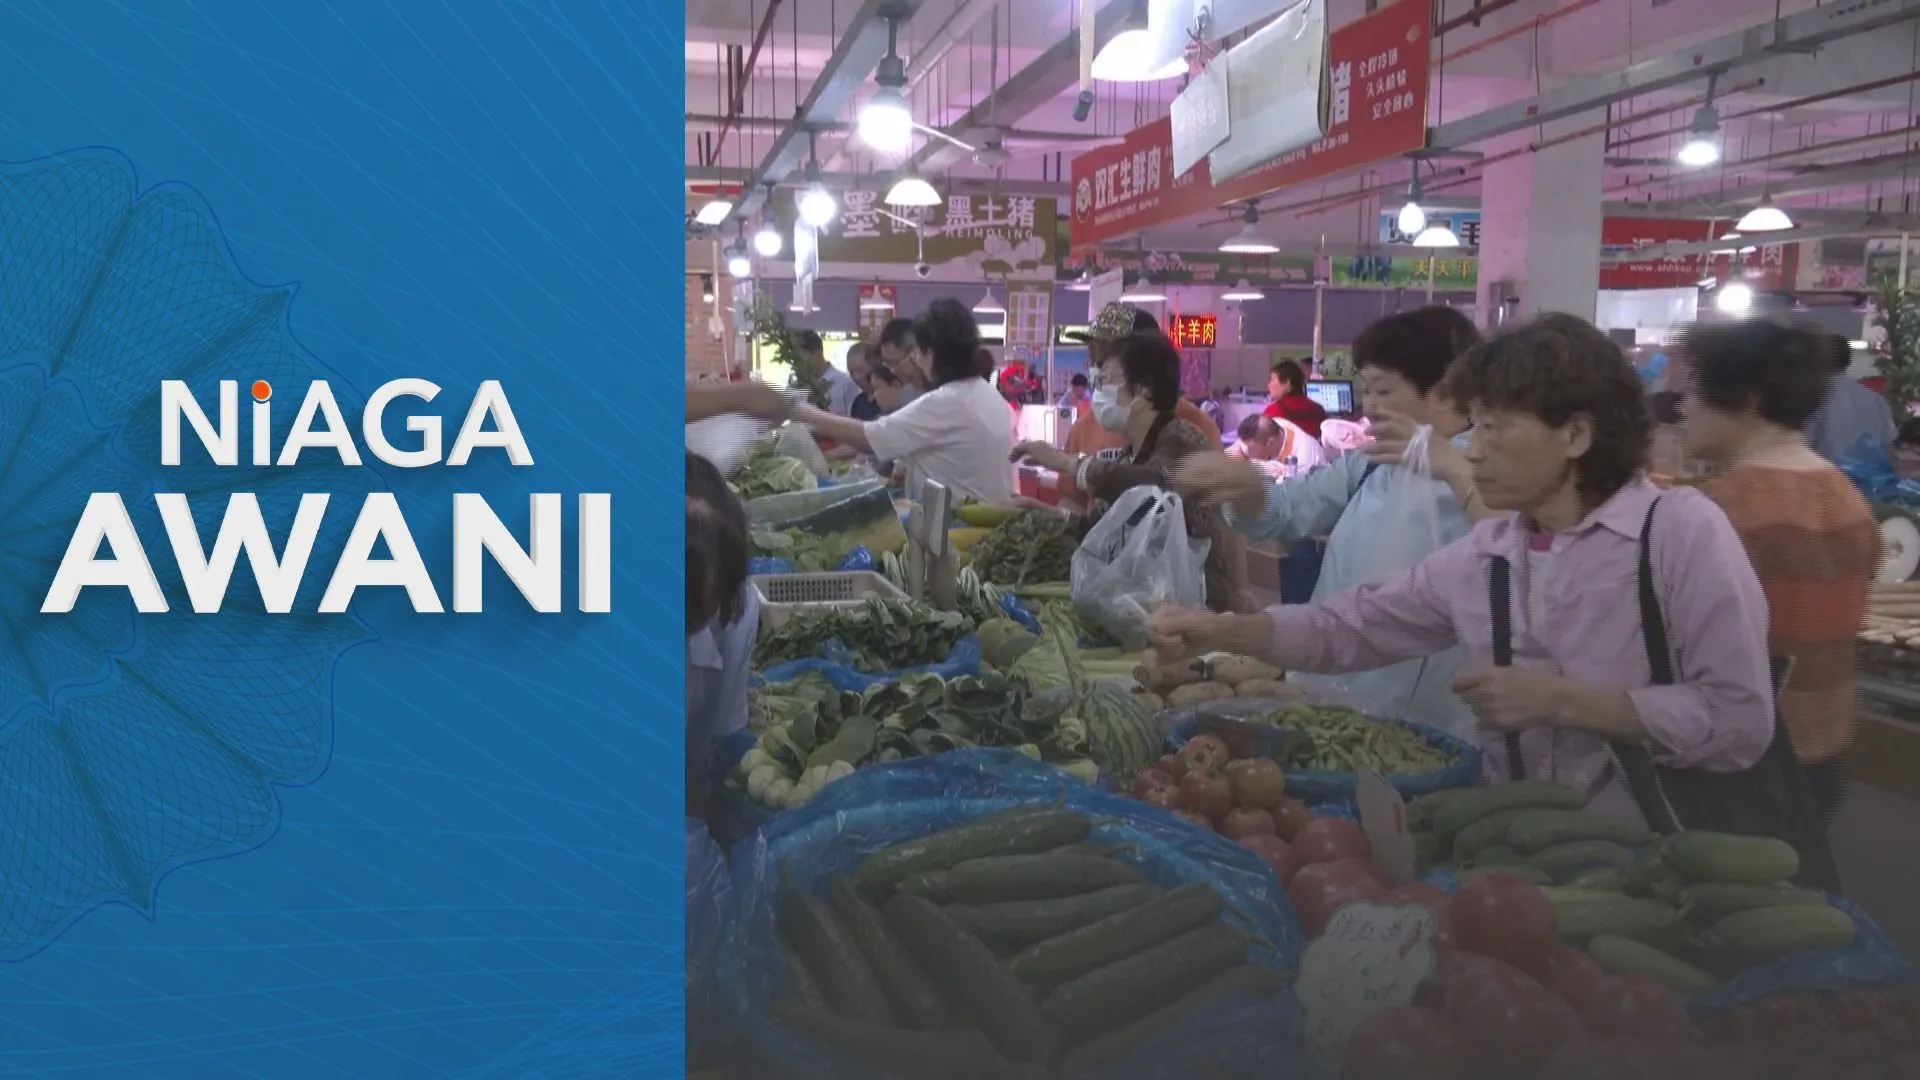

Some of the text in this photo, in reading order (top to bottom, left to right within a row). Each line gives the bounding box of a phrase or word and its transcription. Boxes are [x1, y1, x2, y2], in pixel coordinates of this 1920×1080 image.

[1094, 147, 1161, 210] 双汇生鲜肉
[946, 195, 1035, 228] 黑土猪
